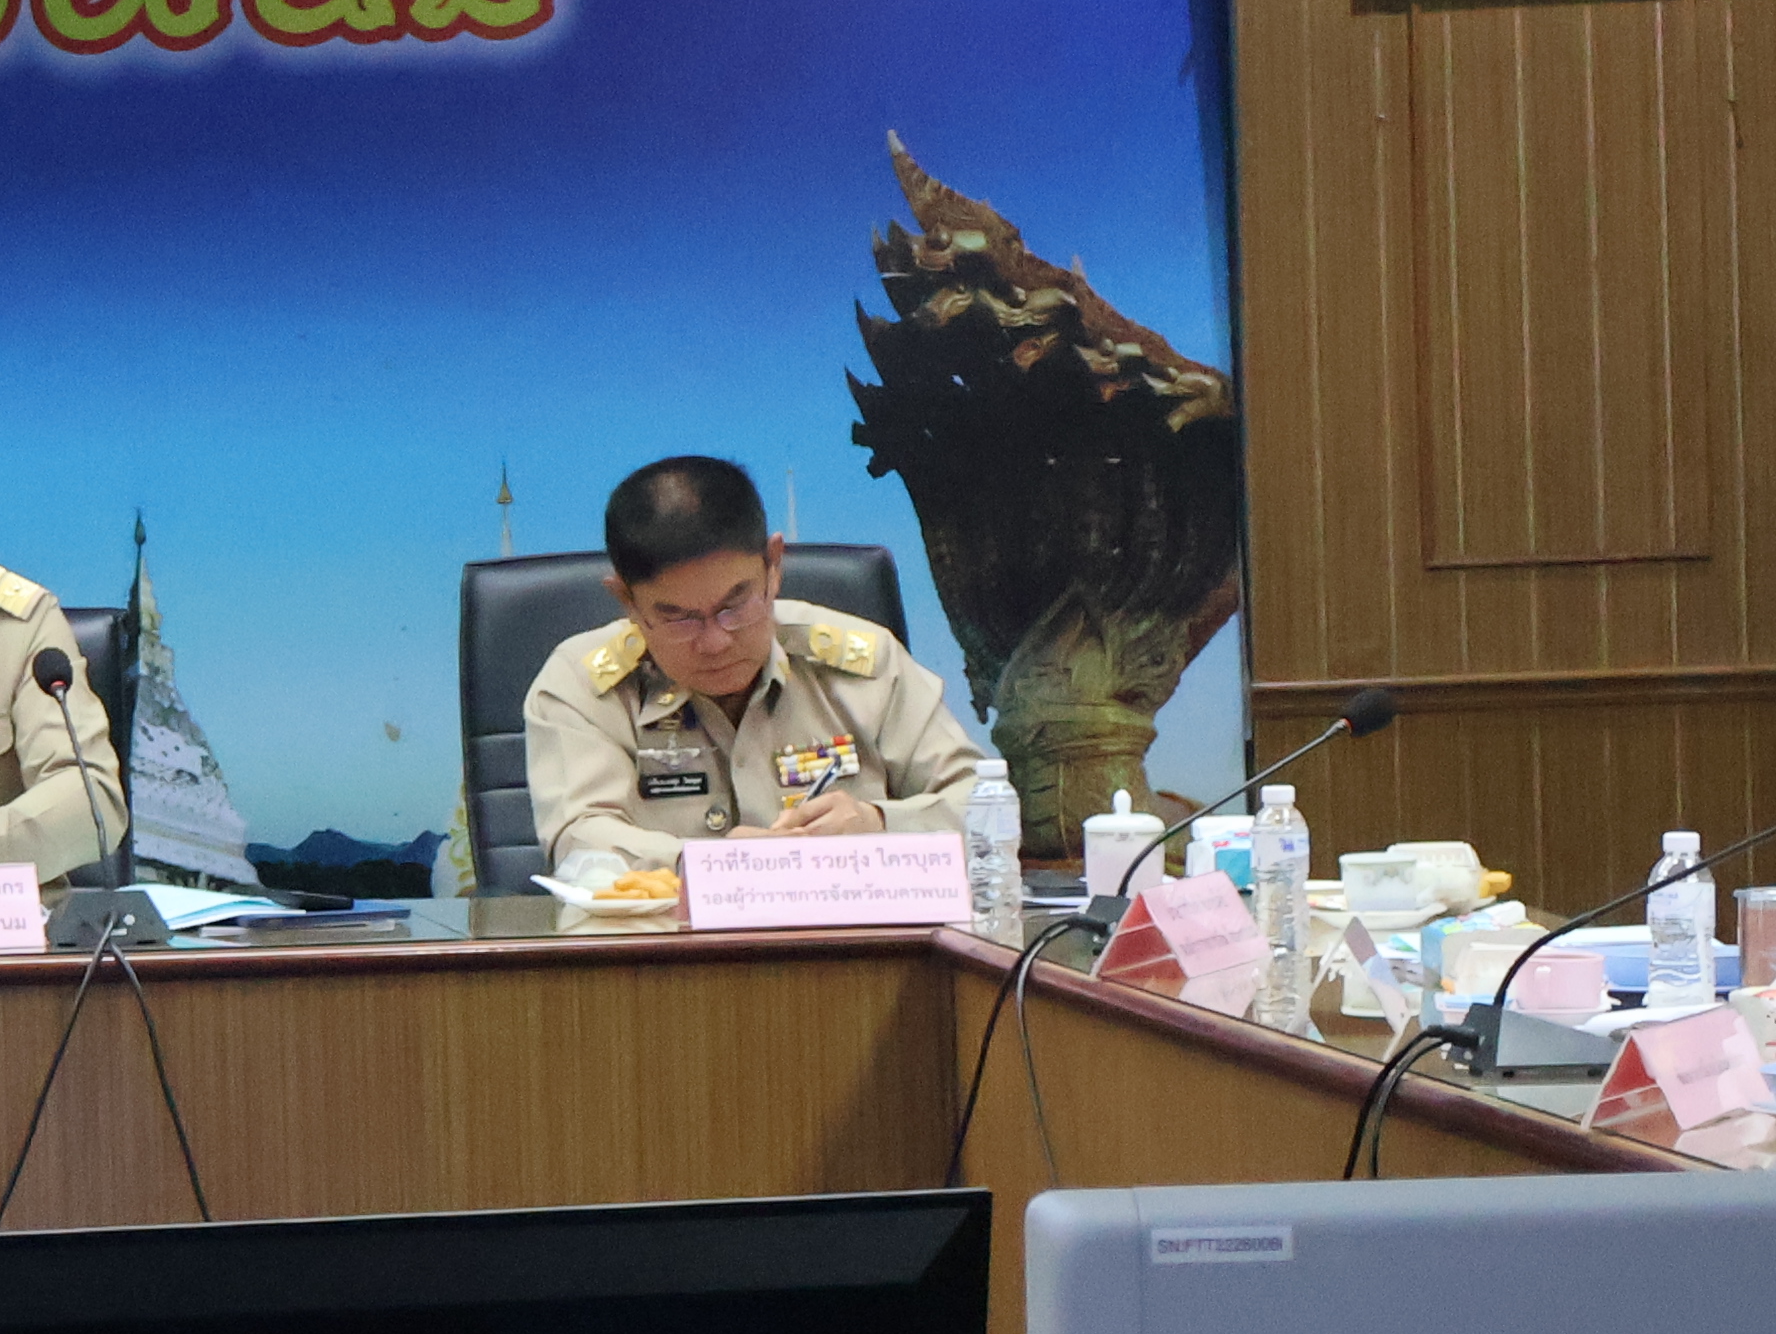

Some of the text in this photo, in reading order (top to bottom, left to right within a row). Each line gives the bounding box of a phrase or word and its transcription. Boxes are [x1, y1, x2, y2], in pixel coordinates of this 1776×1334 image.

[700, 847, 802, 874] ว่าที่ร้อยตรี
[810, 851, 871, 875] รวยรุ่ง
[701, 883, 959, 910] รองผู้ว่าราชการจังหวัดนครพนม
